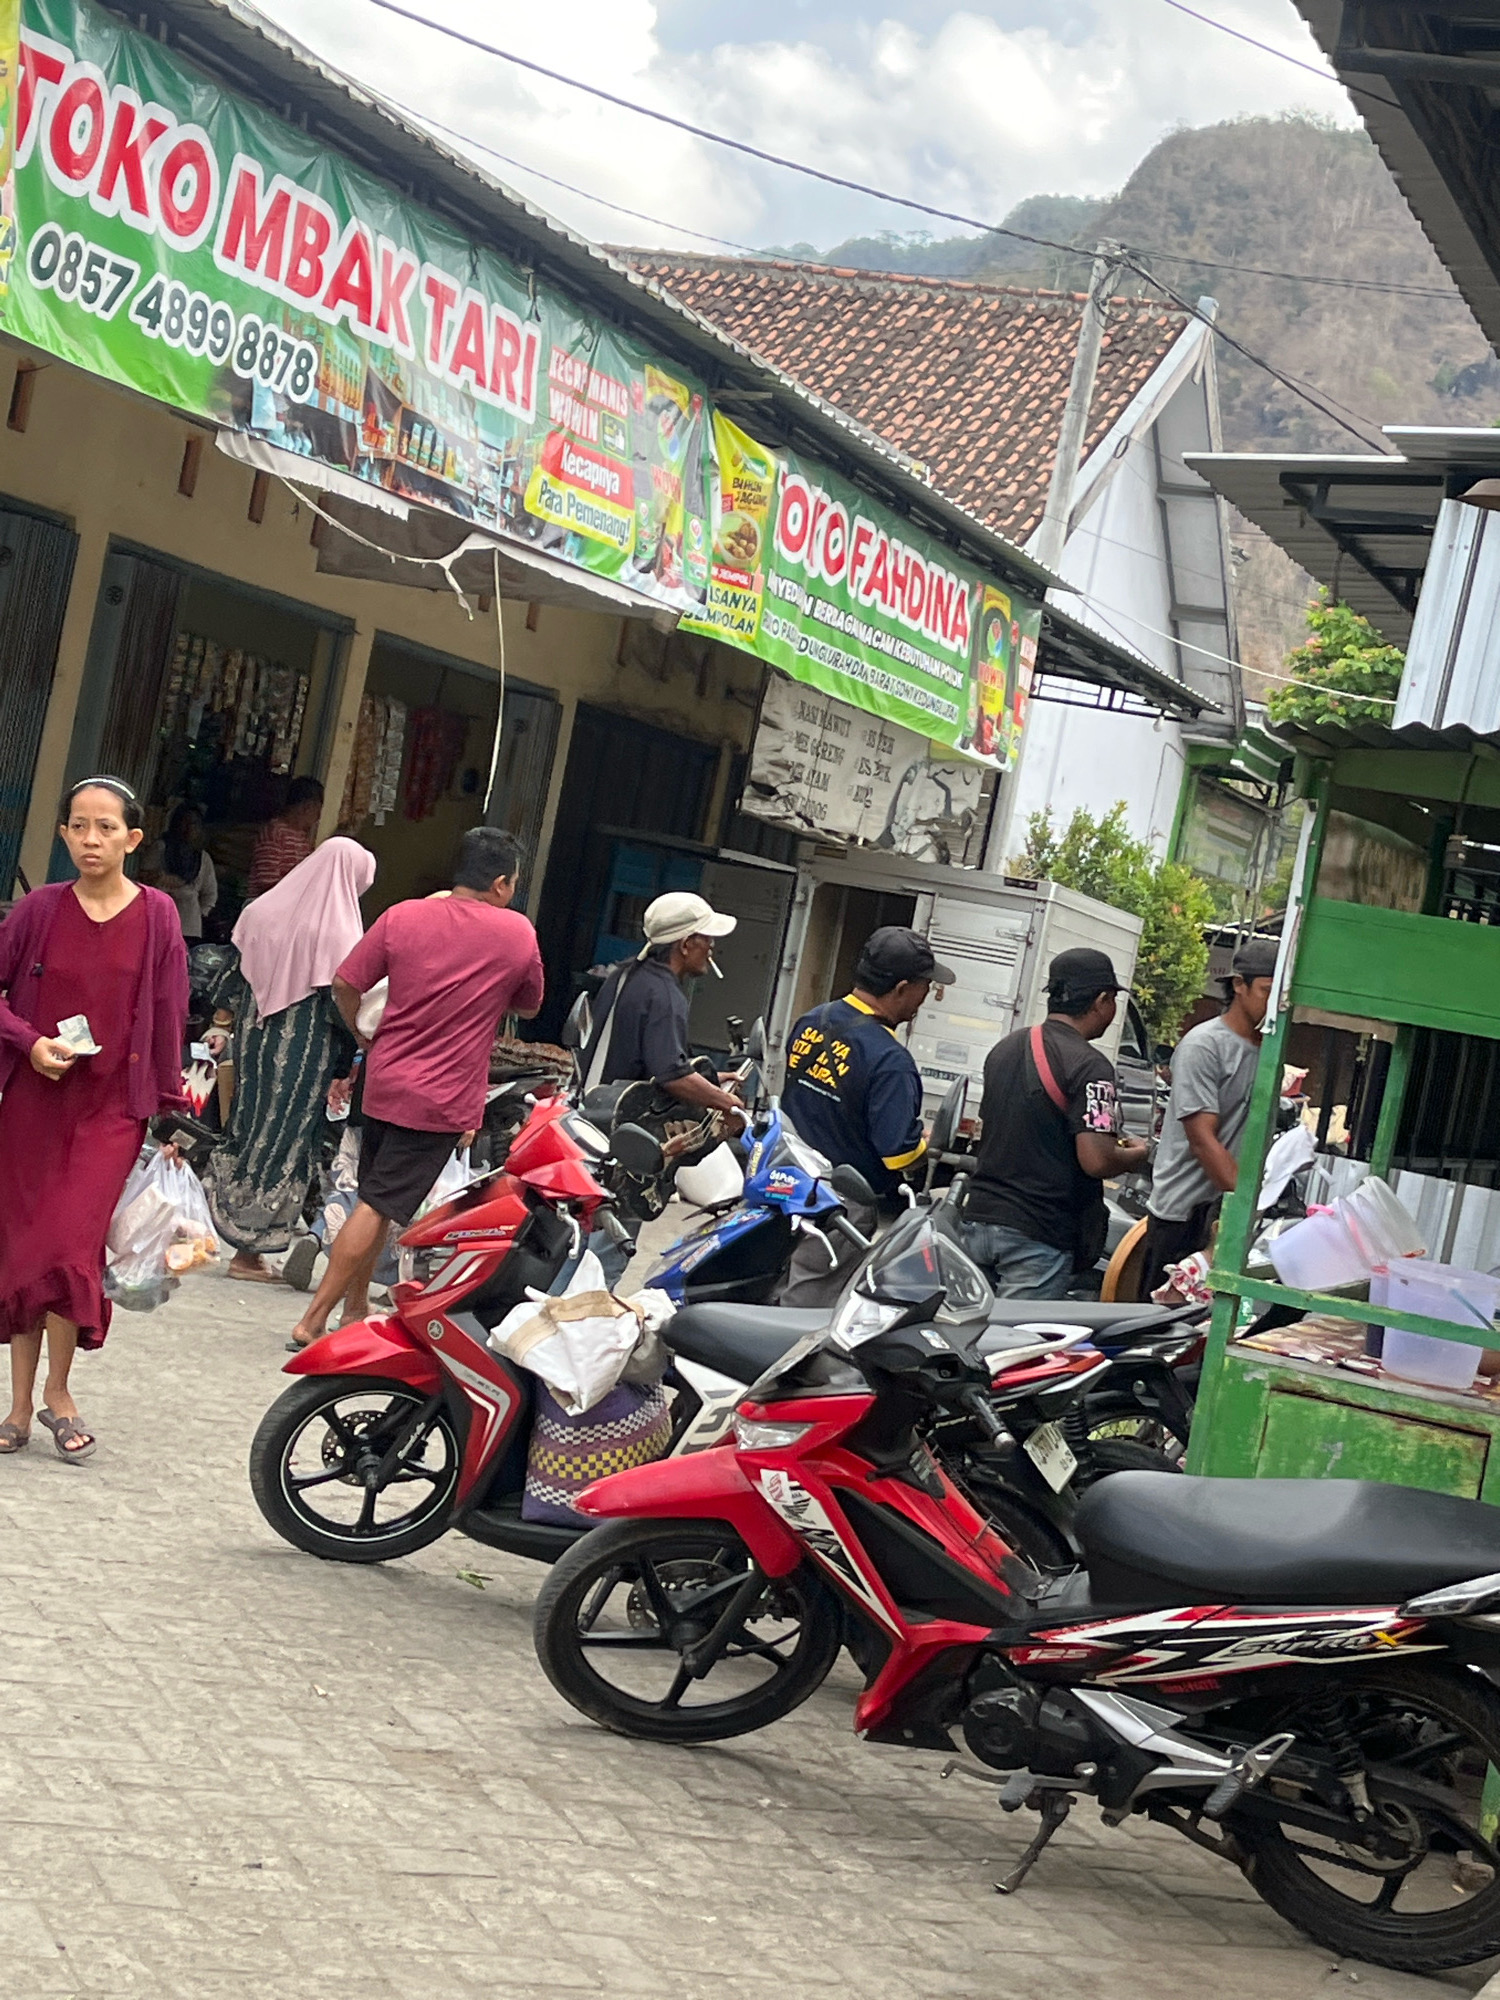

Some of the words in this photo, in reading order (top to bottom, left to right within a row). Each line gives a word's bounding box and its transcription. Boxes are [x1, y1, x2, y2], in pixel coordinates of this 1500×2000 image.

[15, 38, 213, 240] TOKO
[220, 168, 416, 348] MBAK
[423, 274, 538, 413] TARI
[29, 228, 136, 315] 0857
[133, 279, 232, 360] 4899
[235, 320, 316, 398] 8878
[548, 386, 599, 443] WOWIN
[588, 368, 629, 418] MANIS
[559, 441, 620, 497] Kecapnya
[539, 478, 563, 515] Para
[566, 490, 631, 548] Pemenang!
[709, 584, 757, 614] SANYA
[850, 525, 970, 650] FAHDINA
[1026, 1647, 1093, 1661] 125
